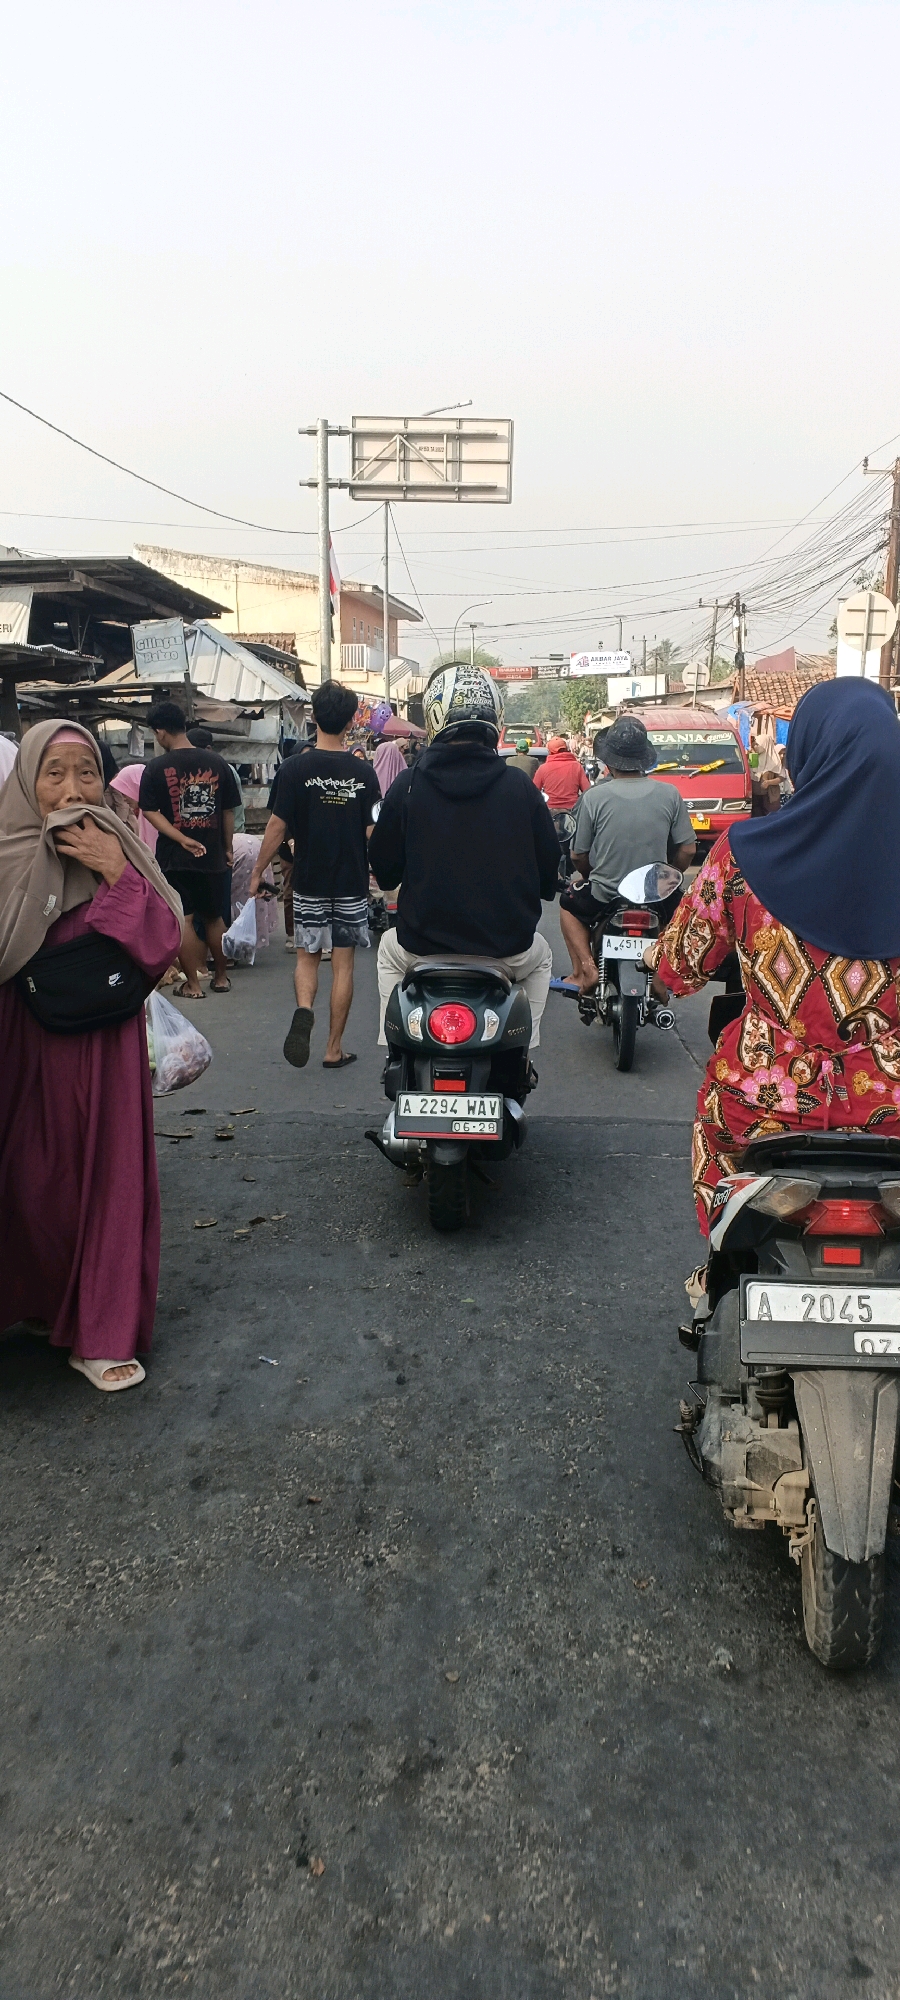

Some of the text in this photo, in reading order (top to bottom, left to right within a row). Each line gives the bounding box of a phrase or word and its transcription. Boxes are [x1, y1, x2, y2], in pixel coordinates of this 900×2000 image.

[652, 733, 705, 744] RANIA
[606, 938, 643, 951] A 4511
[403, 1098, 497, 1116] A 2294 WAV
[757, 1291, 873, 1323] A 2045
